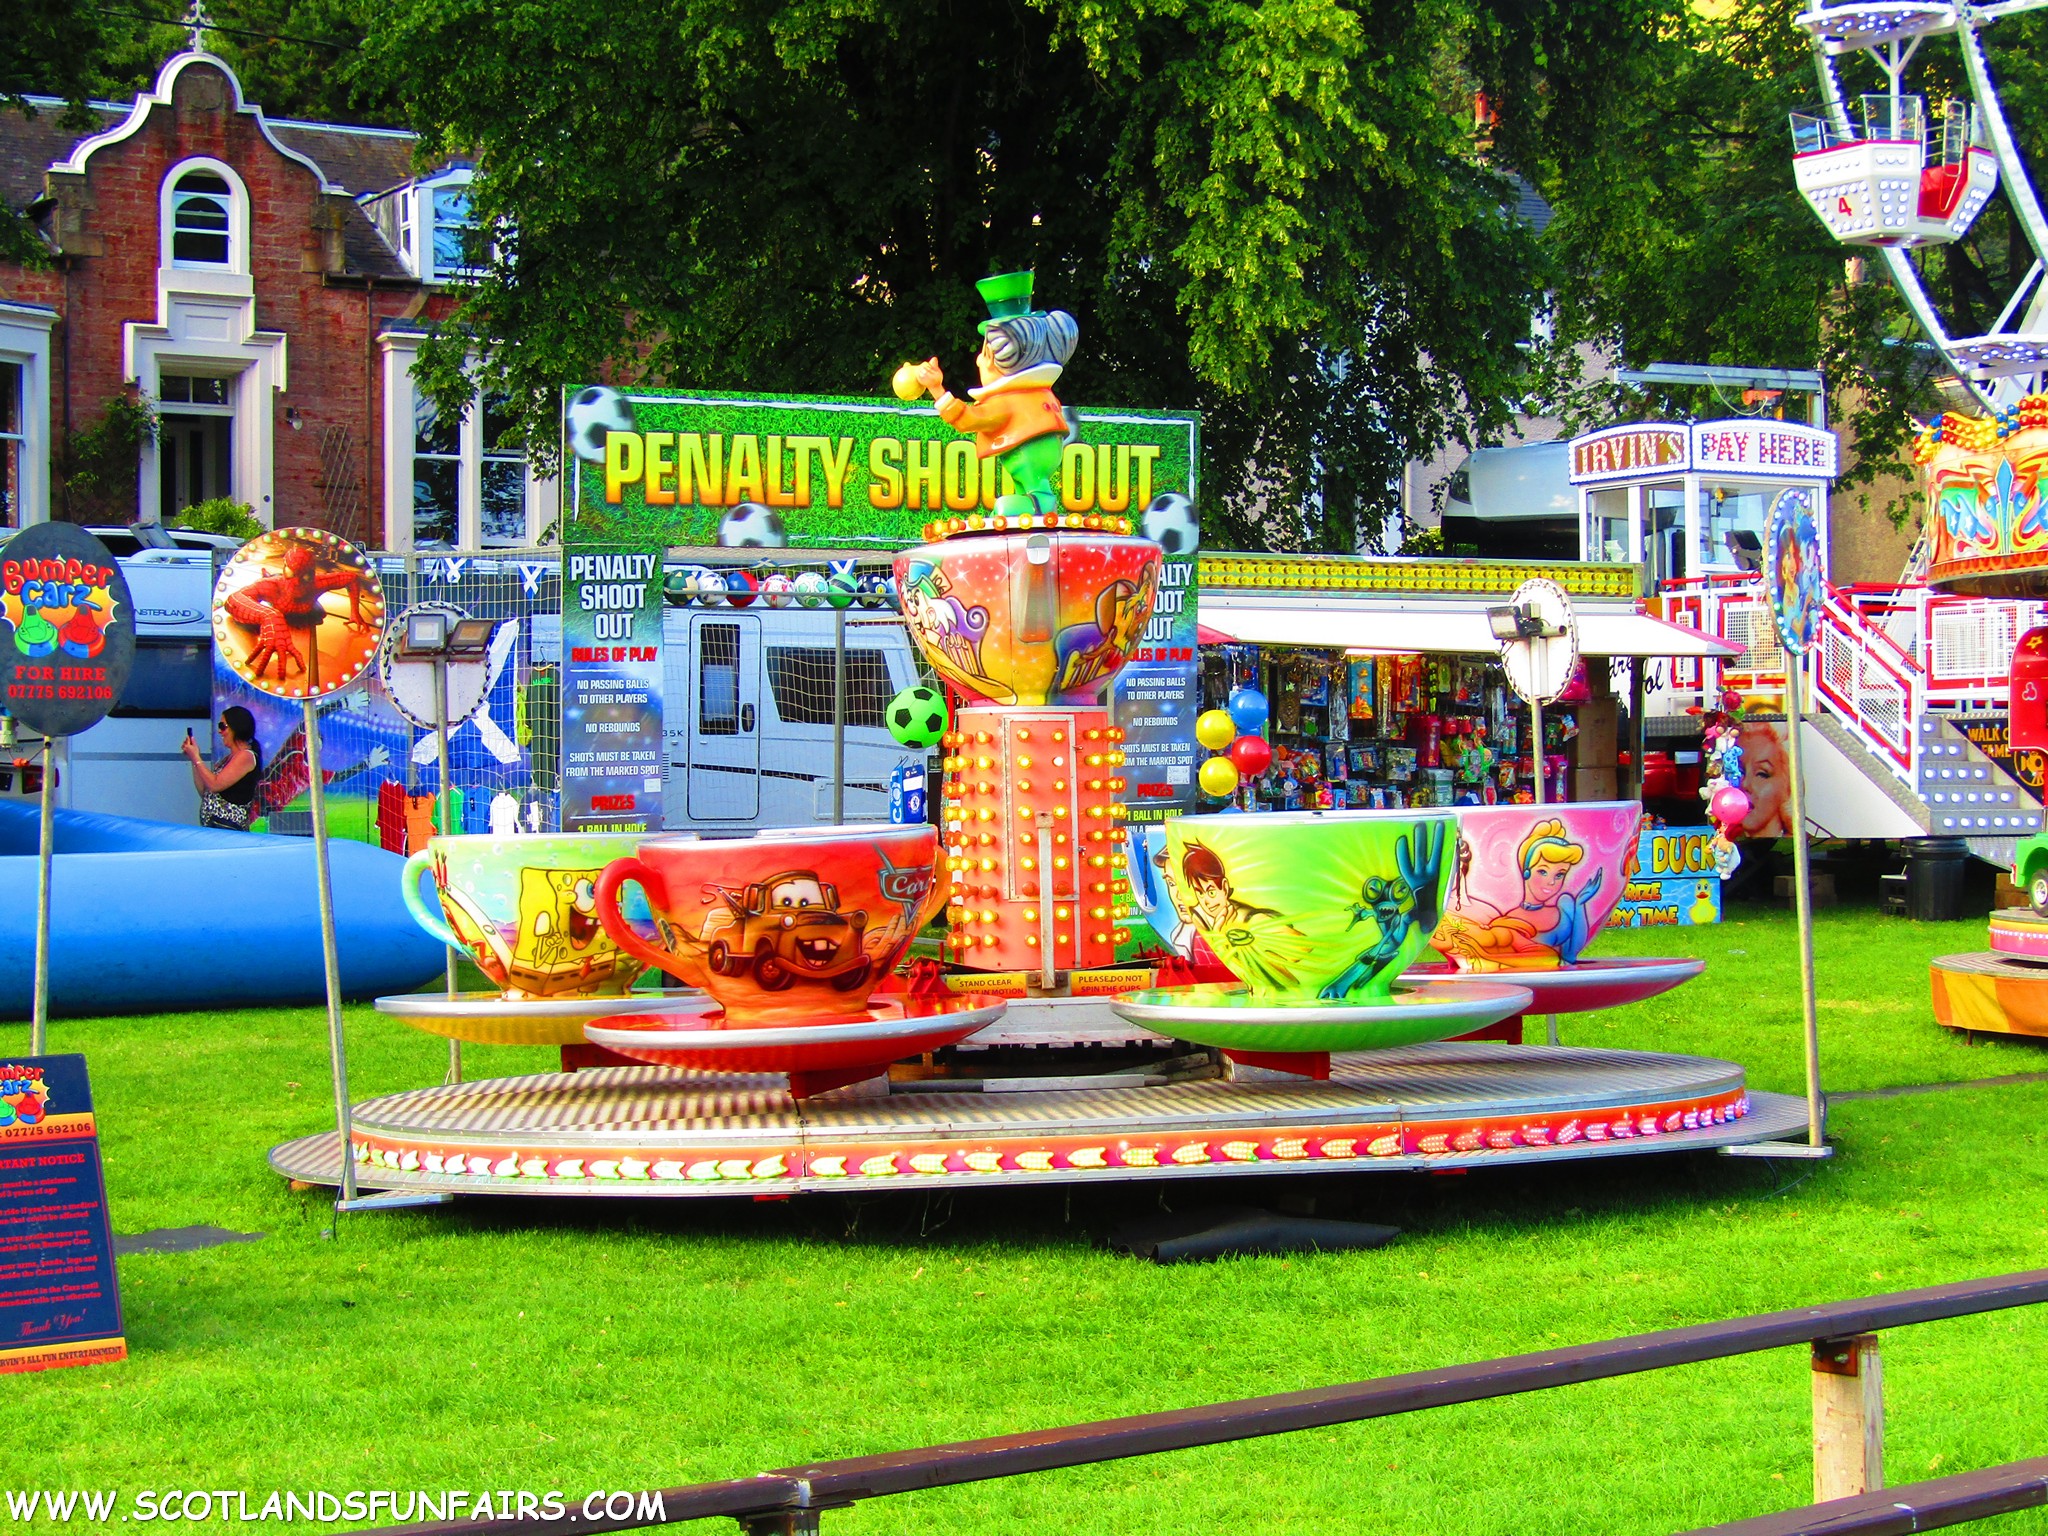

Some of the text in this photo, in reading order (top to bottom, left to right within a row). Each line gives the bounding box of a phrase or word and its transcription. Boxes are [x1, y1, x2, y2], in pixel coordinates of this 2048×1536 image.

[1838, 197, 1852, 216] 4
[1579, 431, 1685, 475] IRVIN'S
[1701, 431, 1827, 467] PAY HERE
[605, 431, 1161, 512] PENALTY SHOO OUT
[570, 554, 656, 581] PENALTY
[1159, 563, 1193, 587] ALTY
[580, 583, 647, 611] SHOOT
[1153, 590, 1185, 613] OOT
[134, 608, 192, 617] NSTERLAND
[594, 612, 634, 639] OUT
[571, 645, 658, 662] RULES OF PLAY
[1155, 647, 1167, 662] OF
[1169, 647, 1194, 662] PLAY
[15, 666, 106, 681] FOR HIRE
[577, 680, 649, 690] NO PASSING BALLS
[1126, 677, 1186, 687] NO PASSING BALLS
[8, 685, 113, 699] 07775 692106
[578, 693, 648, 704] TO OTHER PLAYERS
[1127, 690, 1185, 700] TO OTHER PLAYERS
[585, 722, 641, 733] NO REBOUNDS
[1133, 717, 1178, 727] NO REBOUNDS
[1967, 728, 2001, 742] WALK
[1120, 742, 1191, 753] SHOTS MUST BE TAKEN
[569, 751, 656, 762] SHOTS MUST BE TAKEN
[1136, 757, 1148, 766] THE
[1149, 756, 1176, 766] MARKED
[1177, 756, 1193, 765] SPOT
[566, 765, 660, 777] FROM THE MARKED SPOT
[1137, 783, 1174, 797] PRIZES
[591, 794, 636, 811] PRIZES
[1127, 810, 1131, 821] 1
[1133, 810, 1152, 821] BALL
[1153, 809, 1163, 820] IN
[1652, 834, 1717, 875] DUCK
[1624, 881, 1662, 902] RIZE
[1605, 905, 1678, 927] ERY TIME
[960, 979, 1011, 988] STAND CLEAR
[1079, 975, 1109, 983] PLEASE
[1127, 974, 1142, 982] NOT
[1081, 985, 1098, 993] SPIN
[1101, 985, 1116, 993] THE
[0, 1065, 45, 1081] mper
[5, 1126, 43, 1138] 07775
[47, 1123, 91, 1134] 692106
[38, 1153, 86, 1166] NOTICE
[0, 1345, 122, 1367] RVIN'S ALL FUN ENTERTAINMENT
